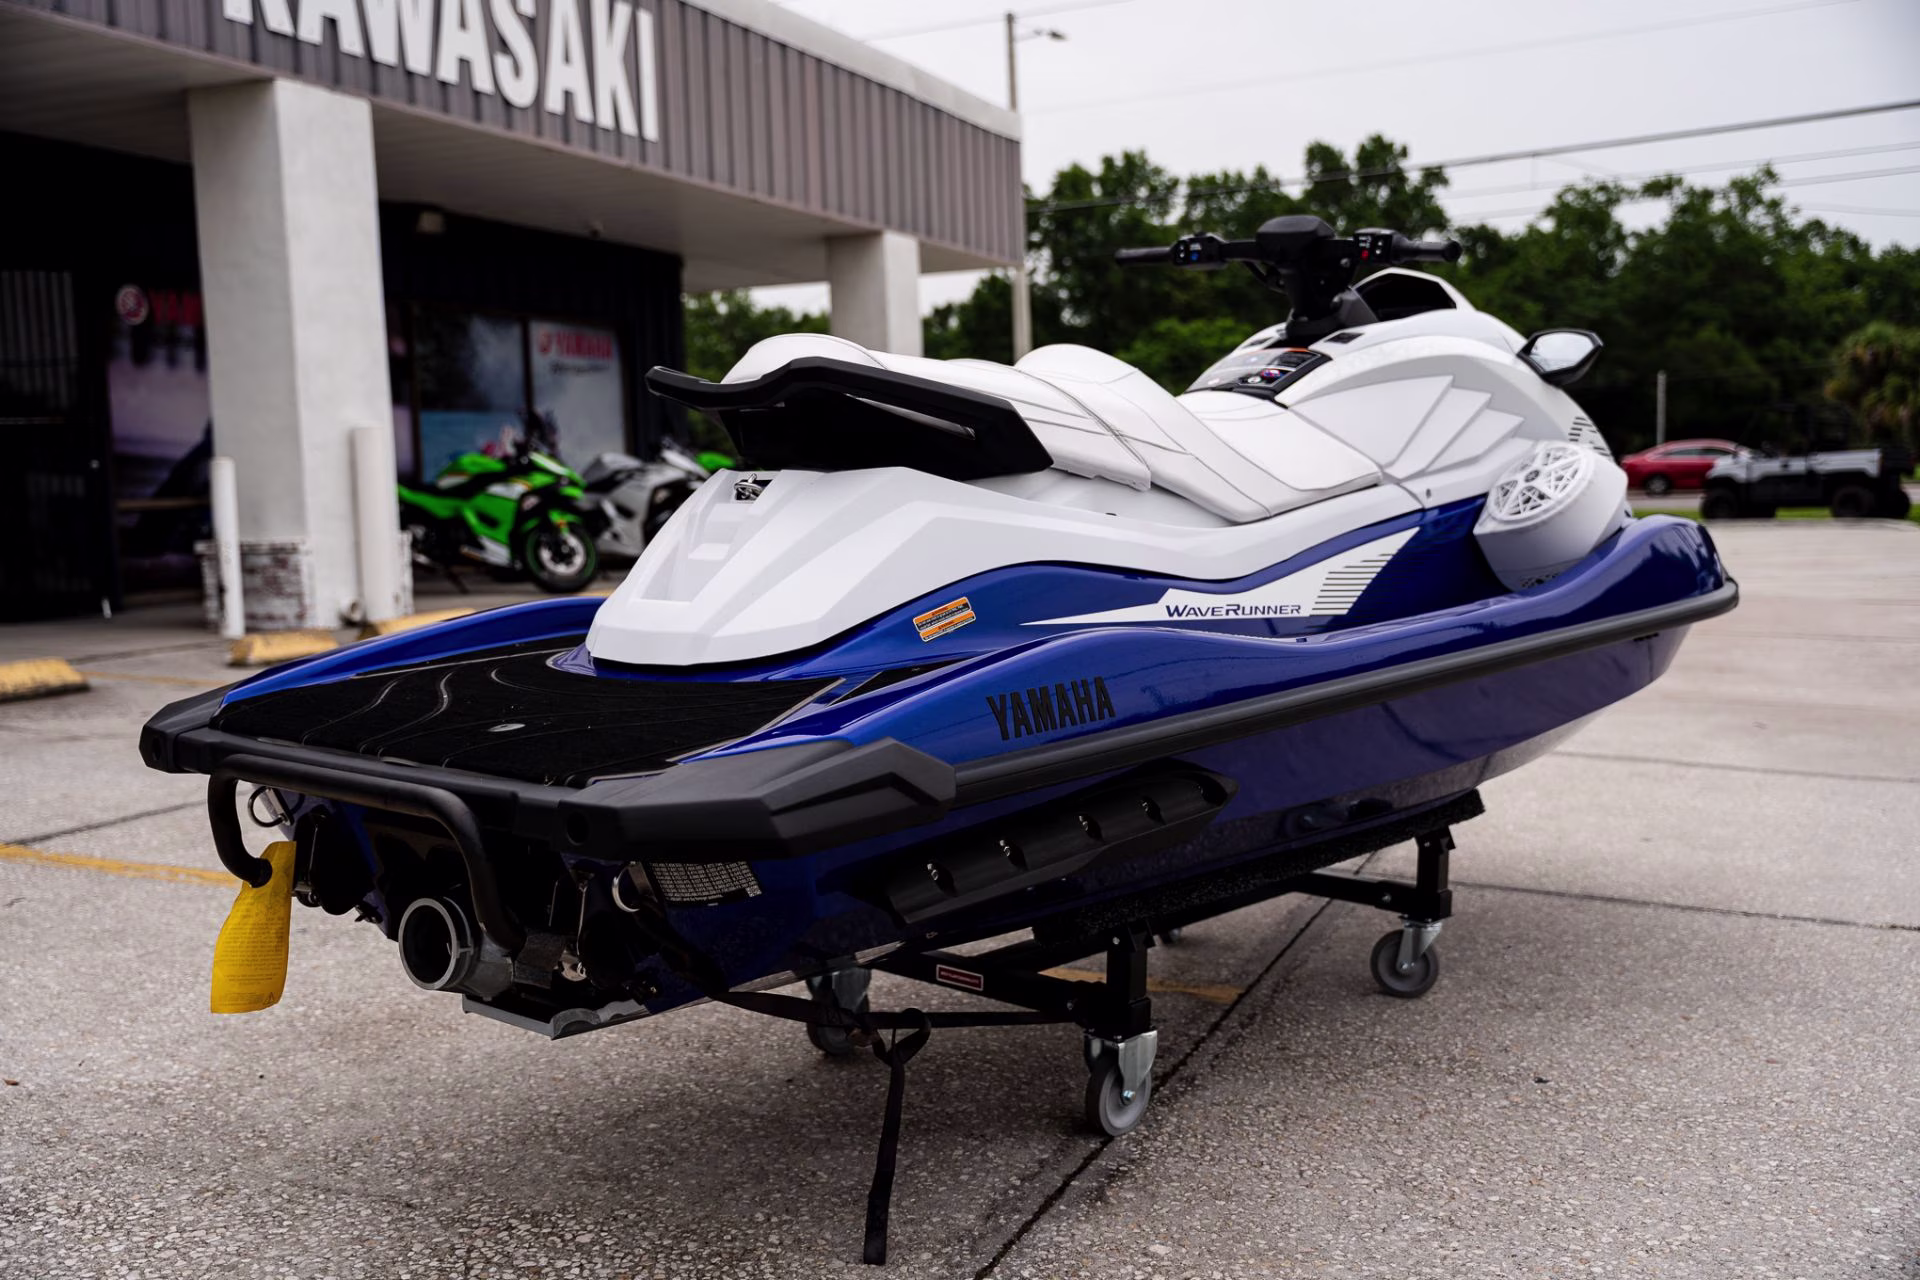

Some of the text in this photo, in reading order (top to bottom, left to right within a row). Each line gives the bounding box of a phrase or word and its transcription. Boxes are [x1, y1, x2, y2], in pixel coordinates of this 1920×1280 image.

[223, 0, 659, 143] WASAKI
[1165, 603, 1302, 618] WAVERUNNER
[985, 675, 1117, 741] YAMAHA
